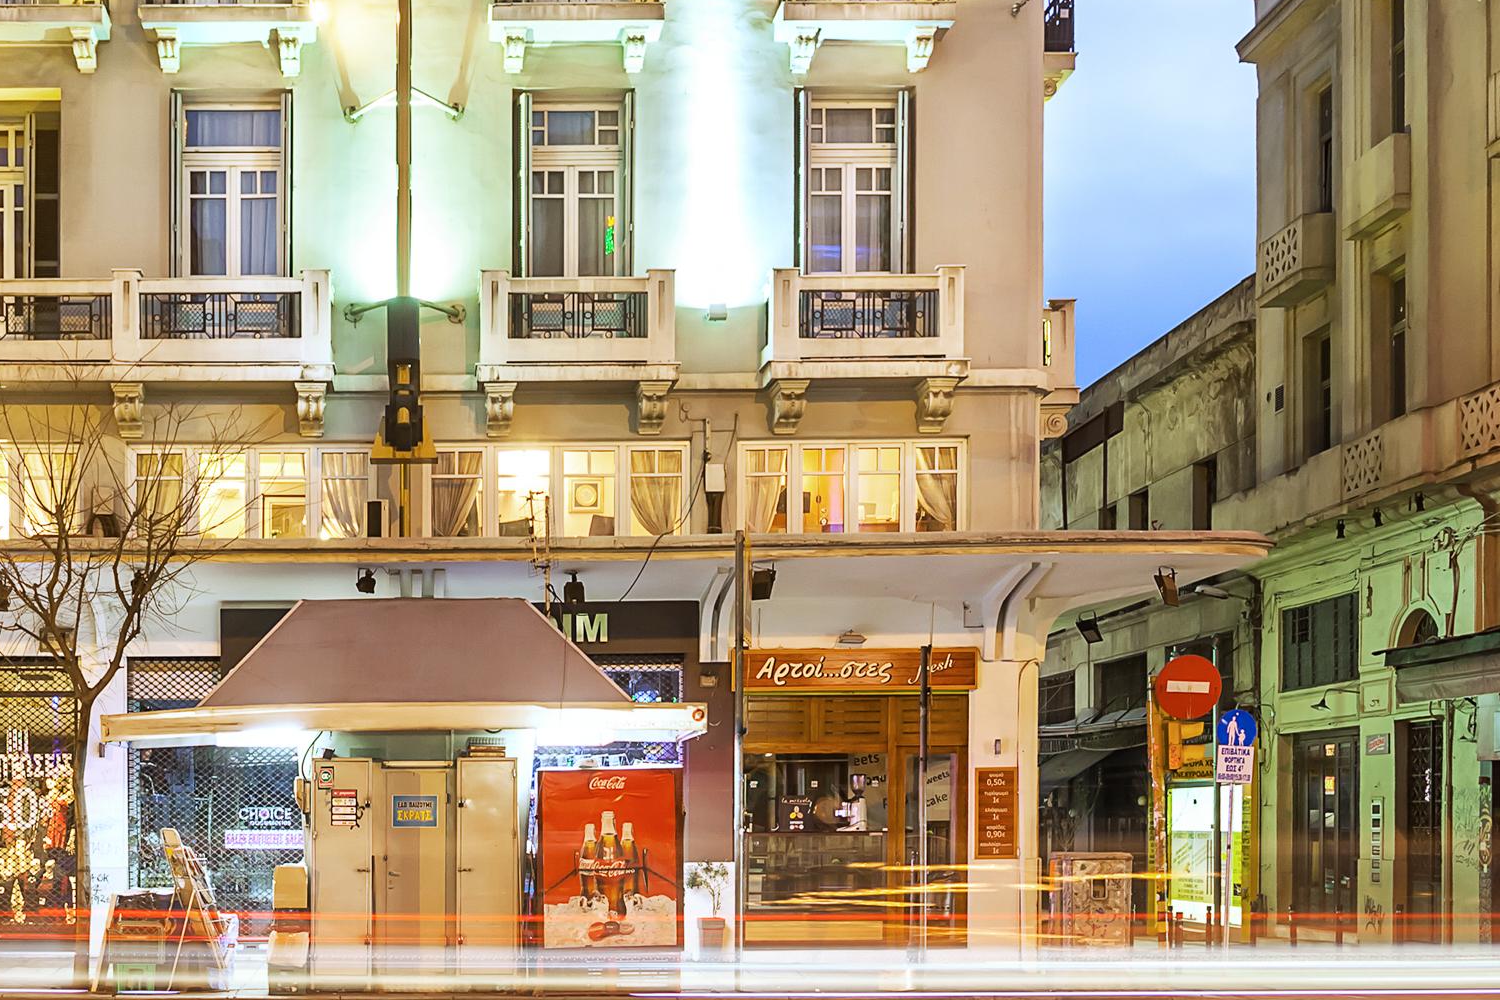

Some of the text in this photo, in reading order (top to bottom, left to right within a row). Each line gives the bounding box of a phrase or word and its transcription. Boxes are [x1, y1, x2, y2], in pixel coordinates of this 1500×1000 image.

[550, 612, 609, 643] IM
[907, 653, 955, 685] fesh
[853, 754, 880, 767] eets
[927, 771, 950, 785] weets
[239, 807, 293, 820] CHOICE
